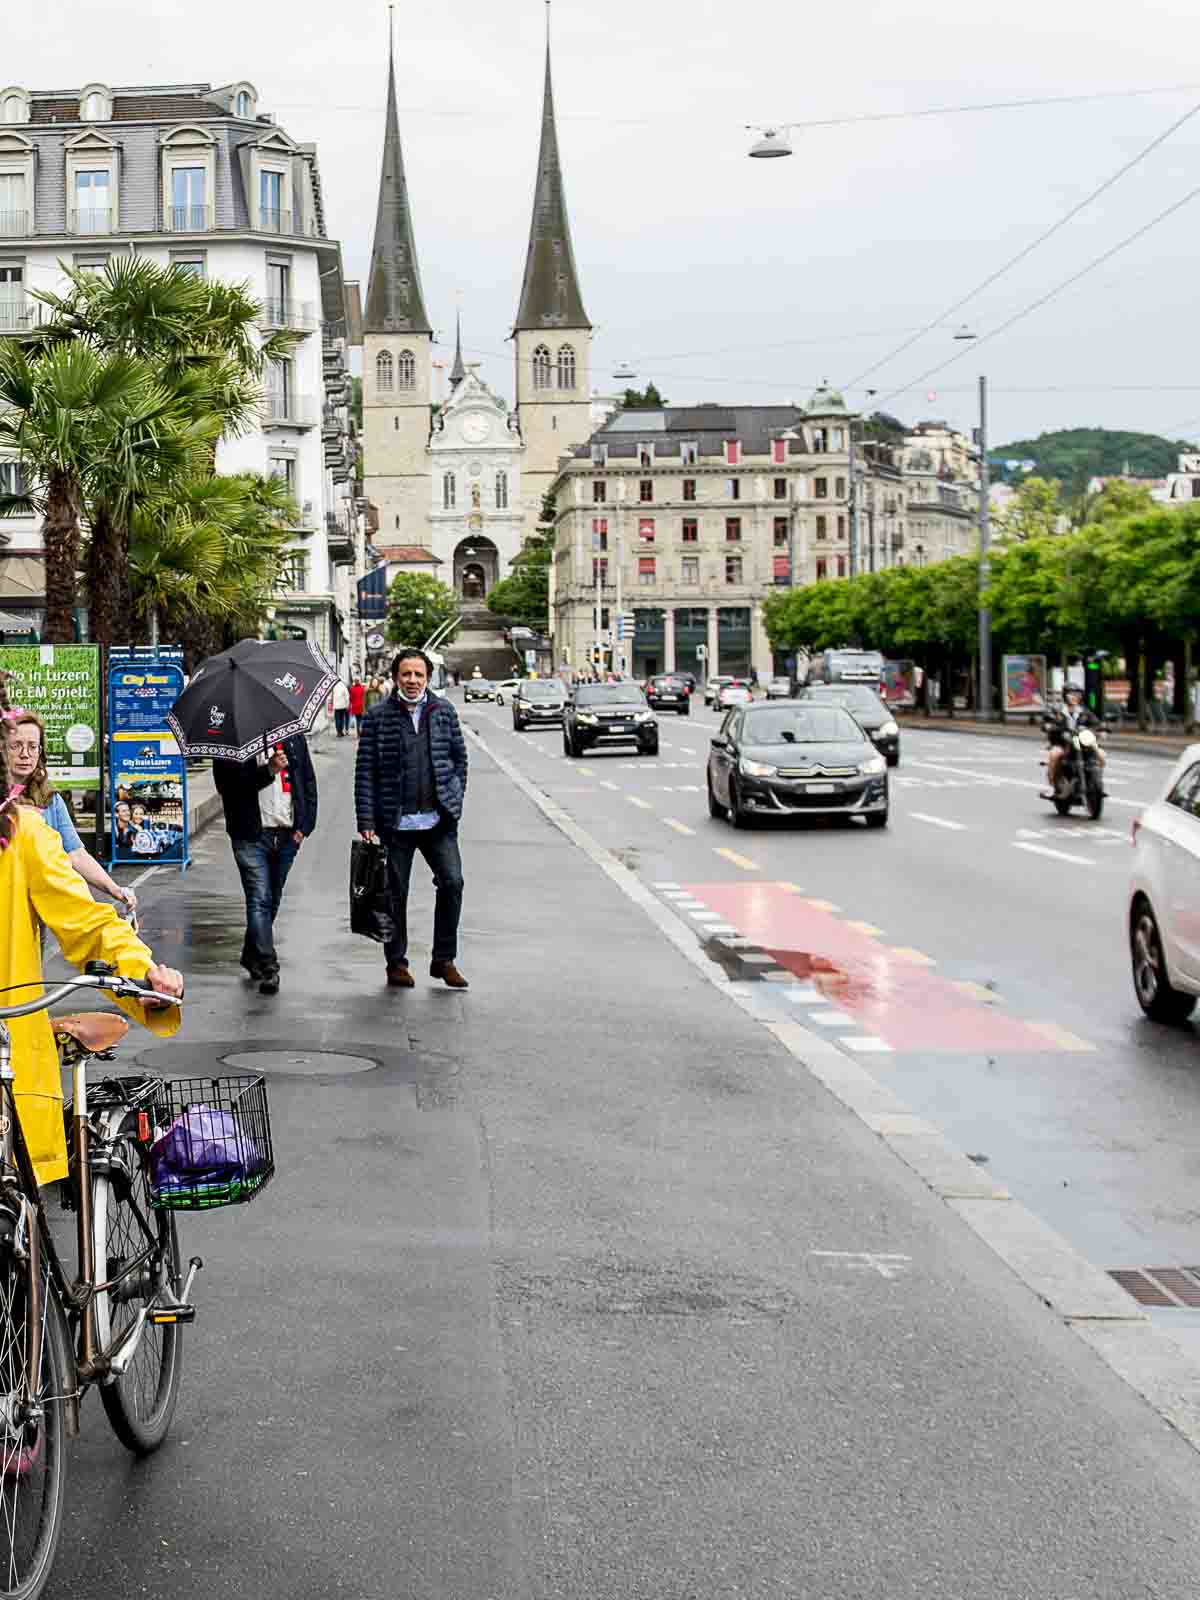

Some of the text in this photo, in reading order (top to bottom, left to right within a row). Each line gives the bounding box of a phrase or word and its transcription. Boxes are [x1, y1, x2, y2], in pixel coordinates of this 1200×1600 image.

[30, 670, 41, 681] in
[46, 670, 89, 681] Luzern
[27, 686, 47, 698] EM
